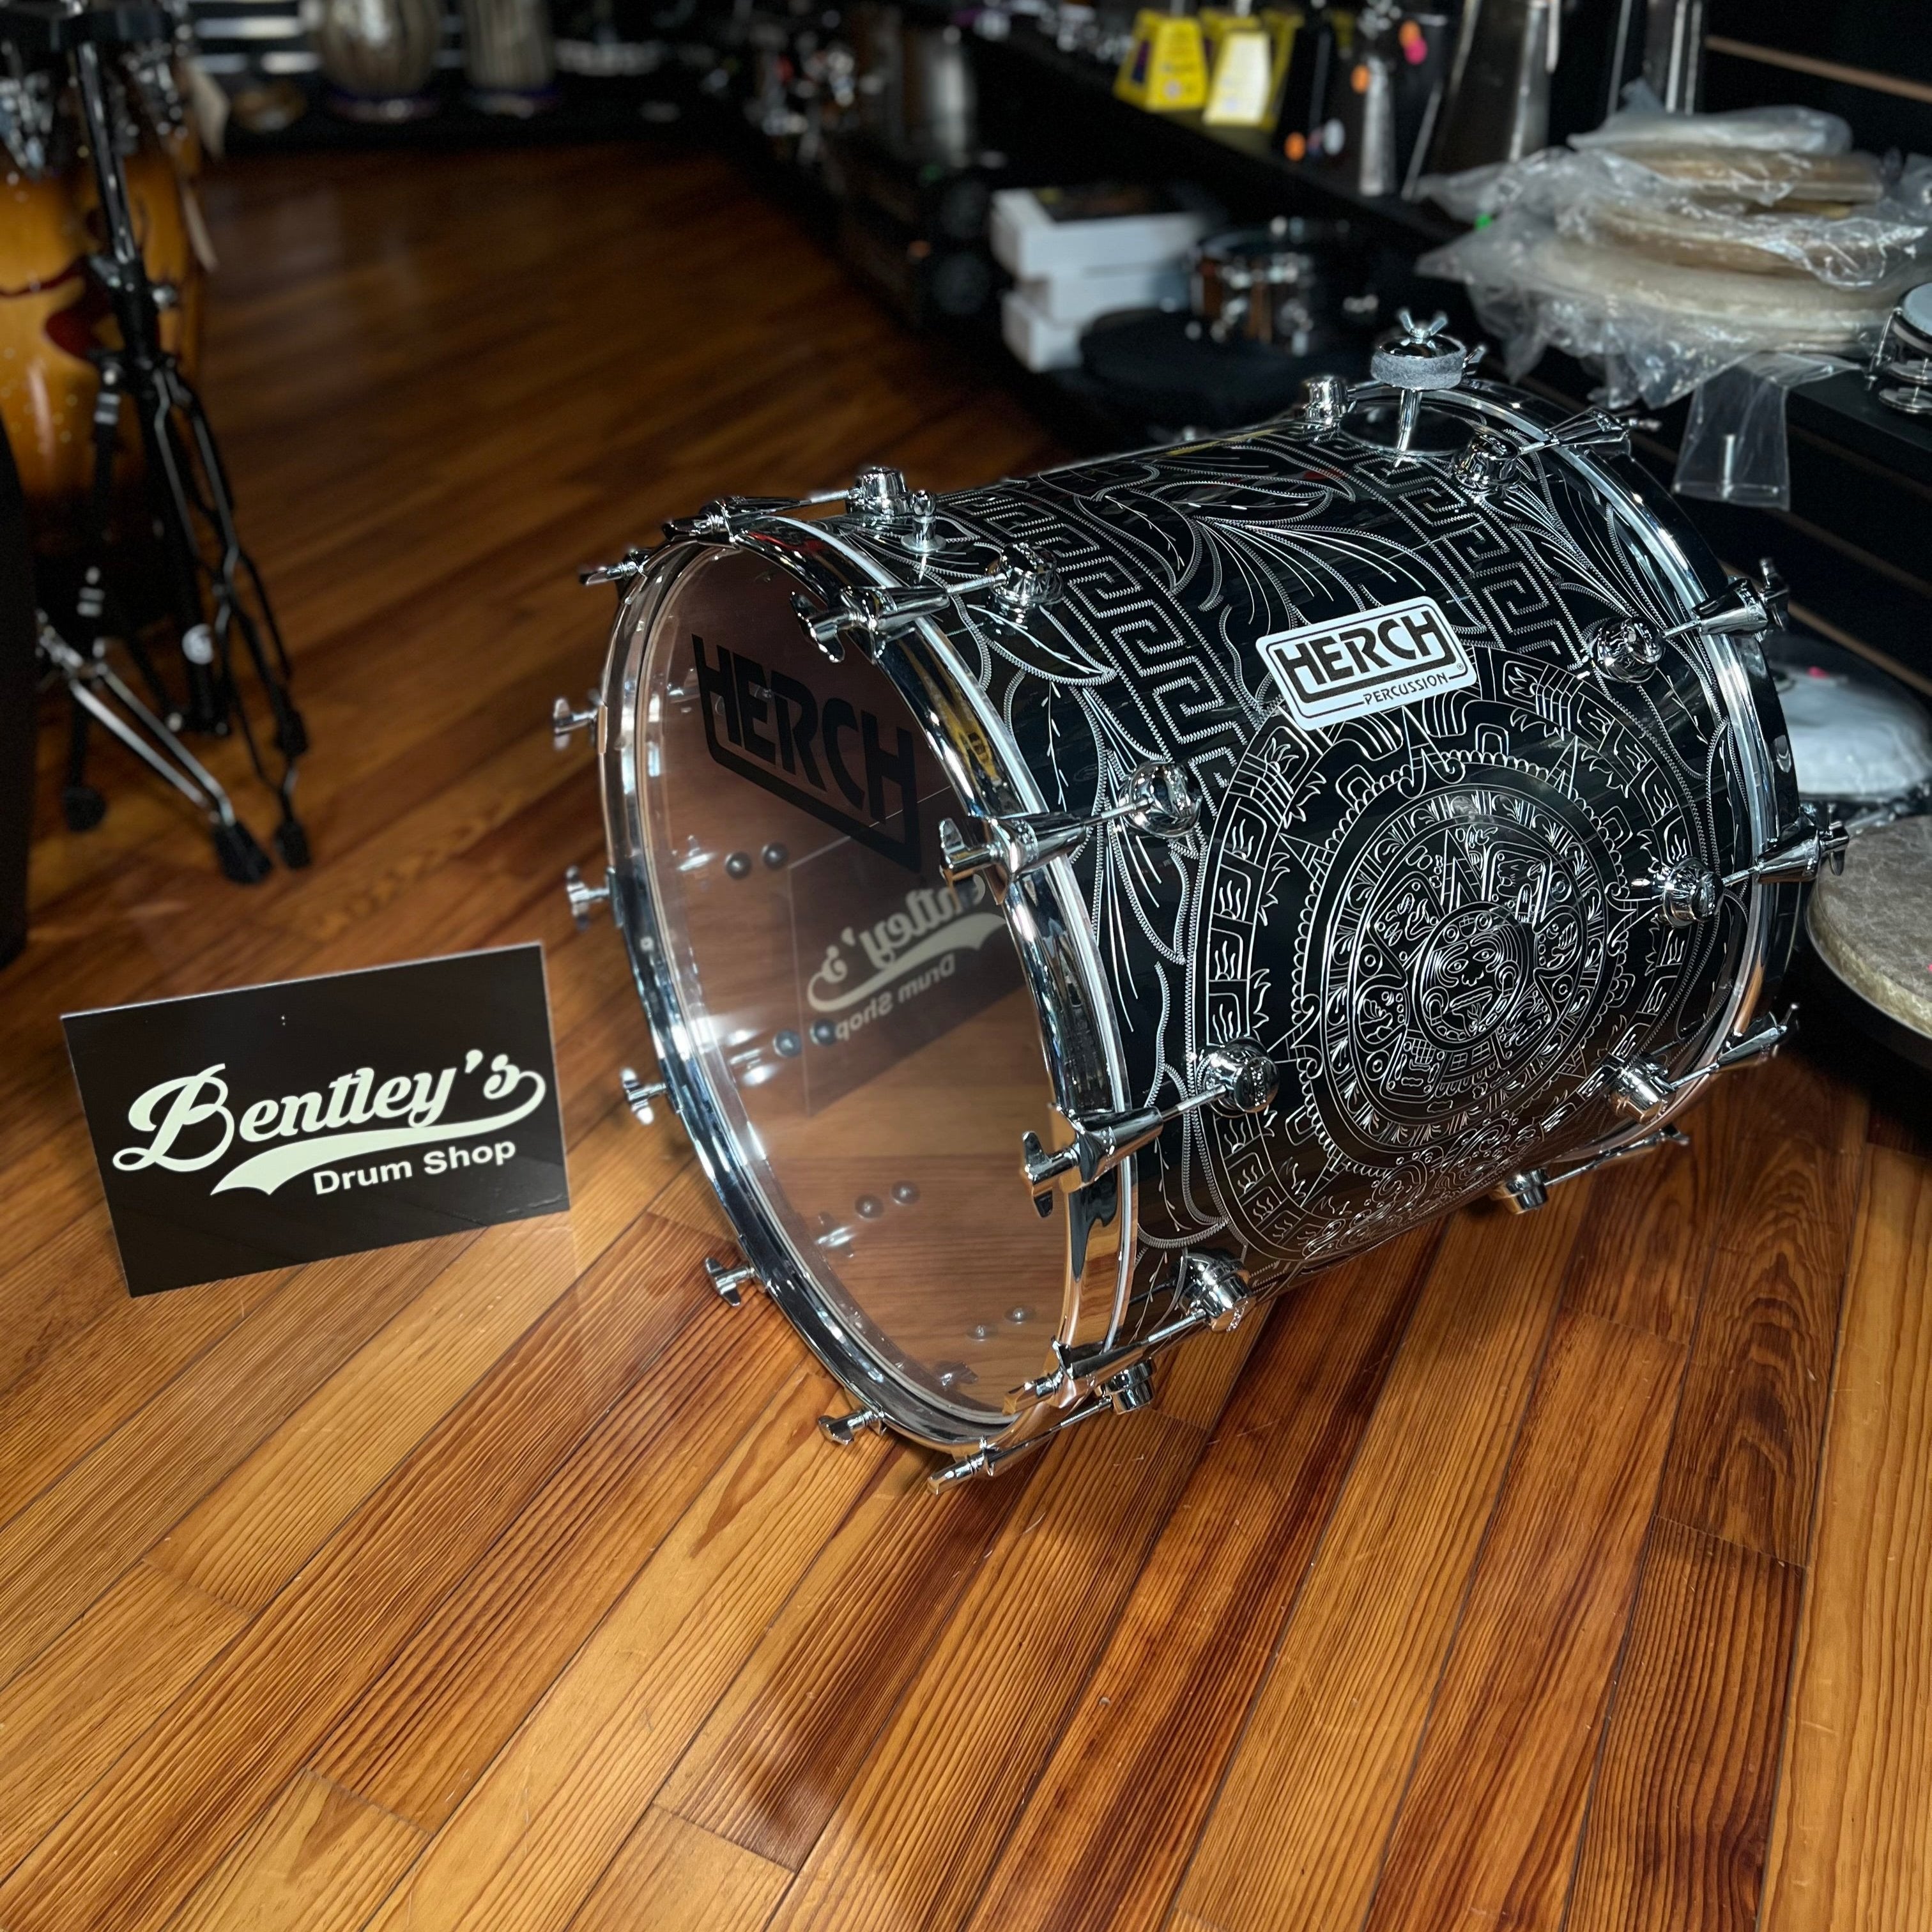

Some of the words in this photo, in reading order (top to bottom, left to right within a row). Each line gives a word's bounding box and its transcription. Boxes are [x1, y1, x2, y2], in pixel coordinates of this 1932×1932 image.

[1273, 610, 1455, 690] HERCH
[1363, 672, 1449, 705] PERCUSSION
[691, 633, 919, 832] HERCH
[112, 1049, 546, 1173] Bentley's
[313, 1161, 413, 1195] Drum
[423, 1140, 516, 1176] Shop
